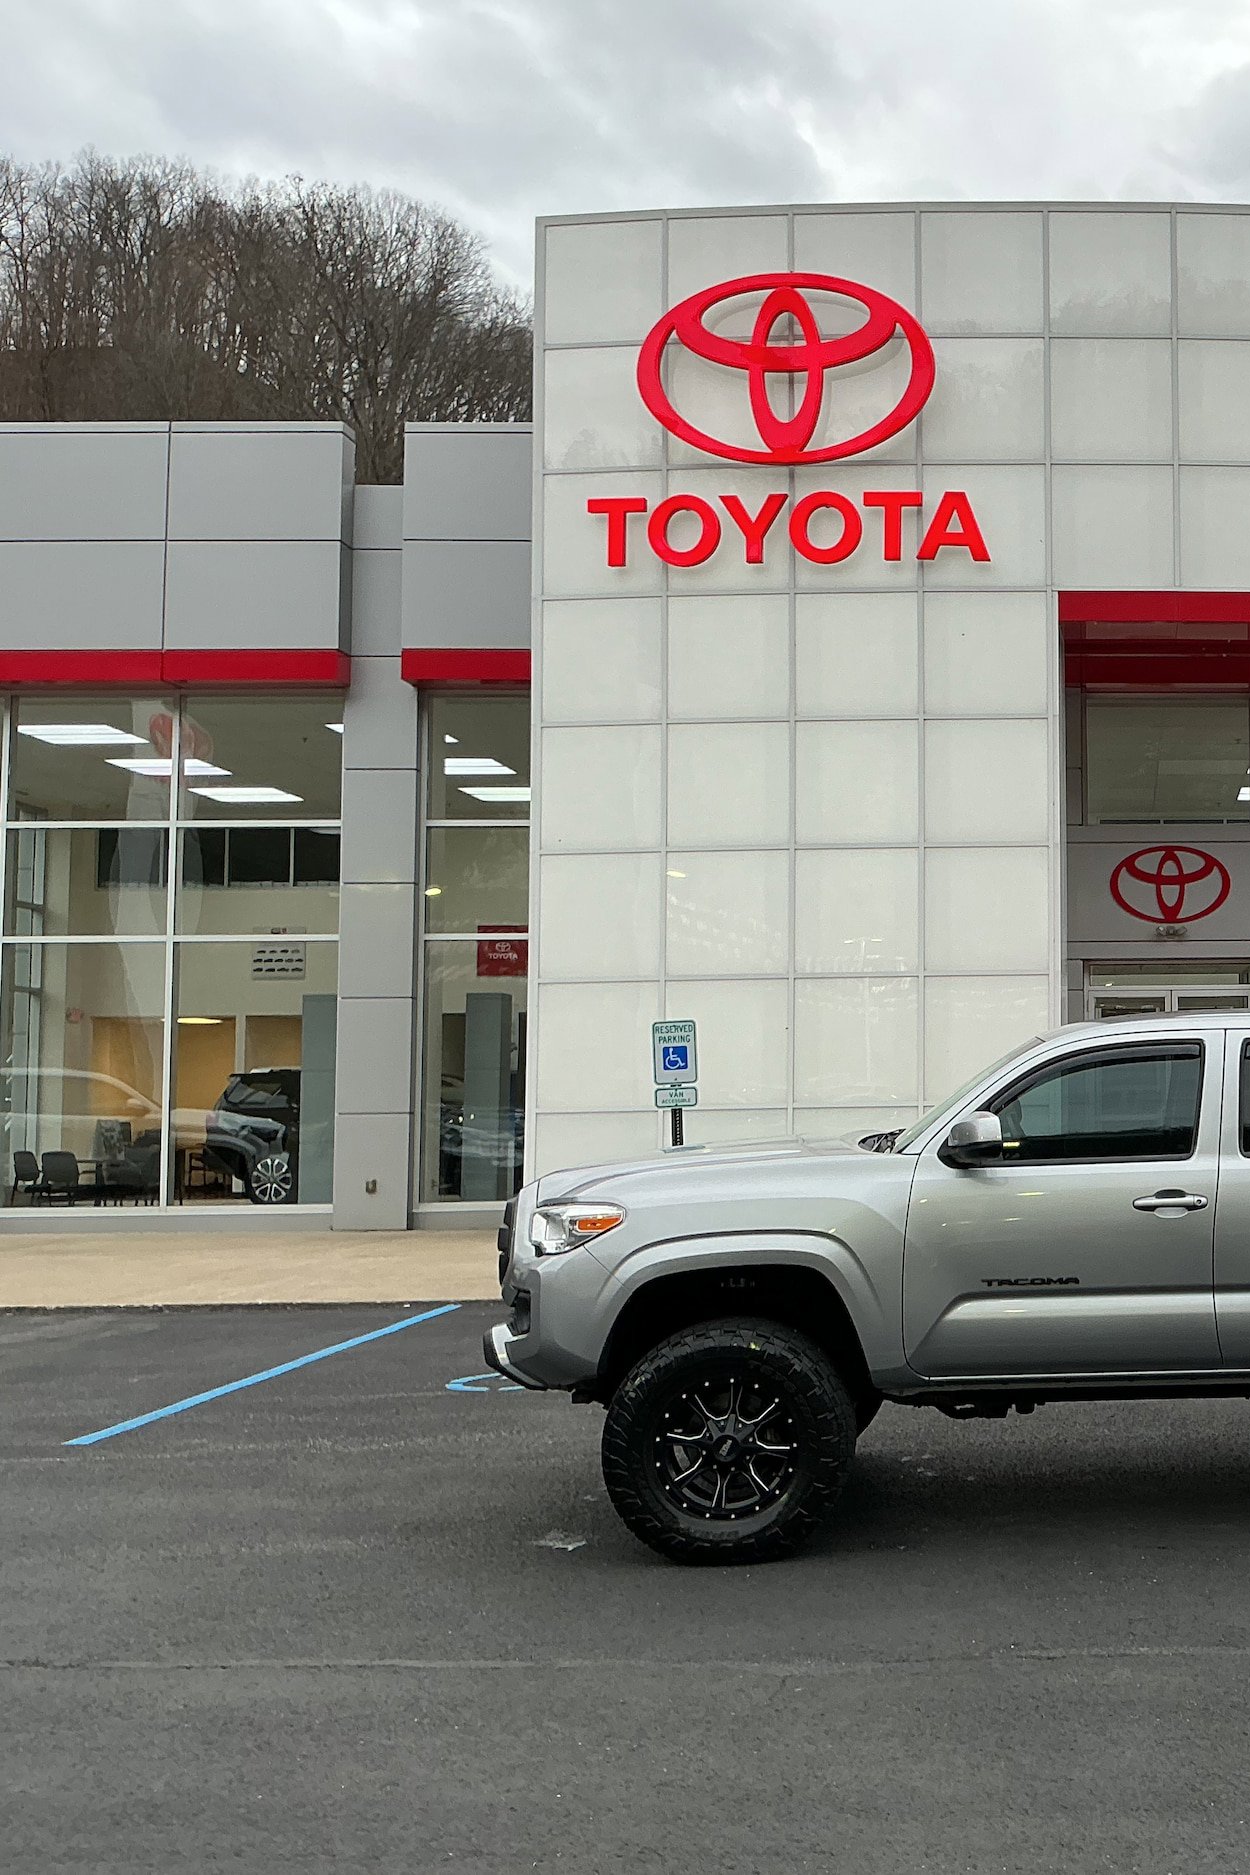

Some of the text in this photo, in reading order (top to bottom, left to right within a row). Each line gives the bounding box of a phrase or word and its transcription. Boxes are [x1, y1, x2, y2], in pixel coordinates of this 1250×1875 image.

[587, 491, 991, 568] TOYOTA
[488, 952, 518, 960] TOYOTA
[655, 1024, 693, 1034] RESERVED
[658, 1034, 691, 1044] PARKING
[981, 1277, 1080, 1287] TACOMA
